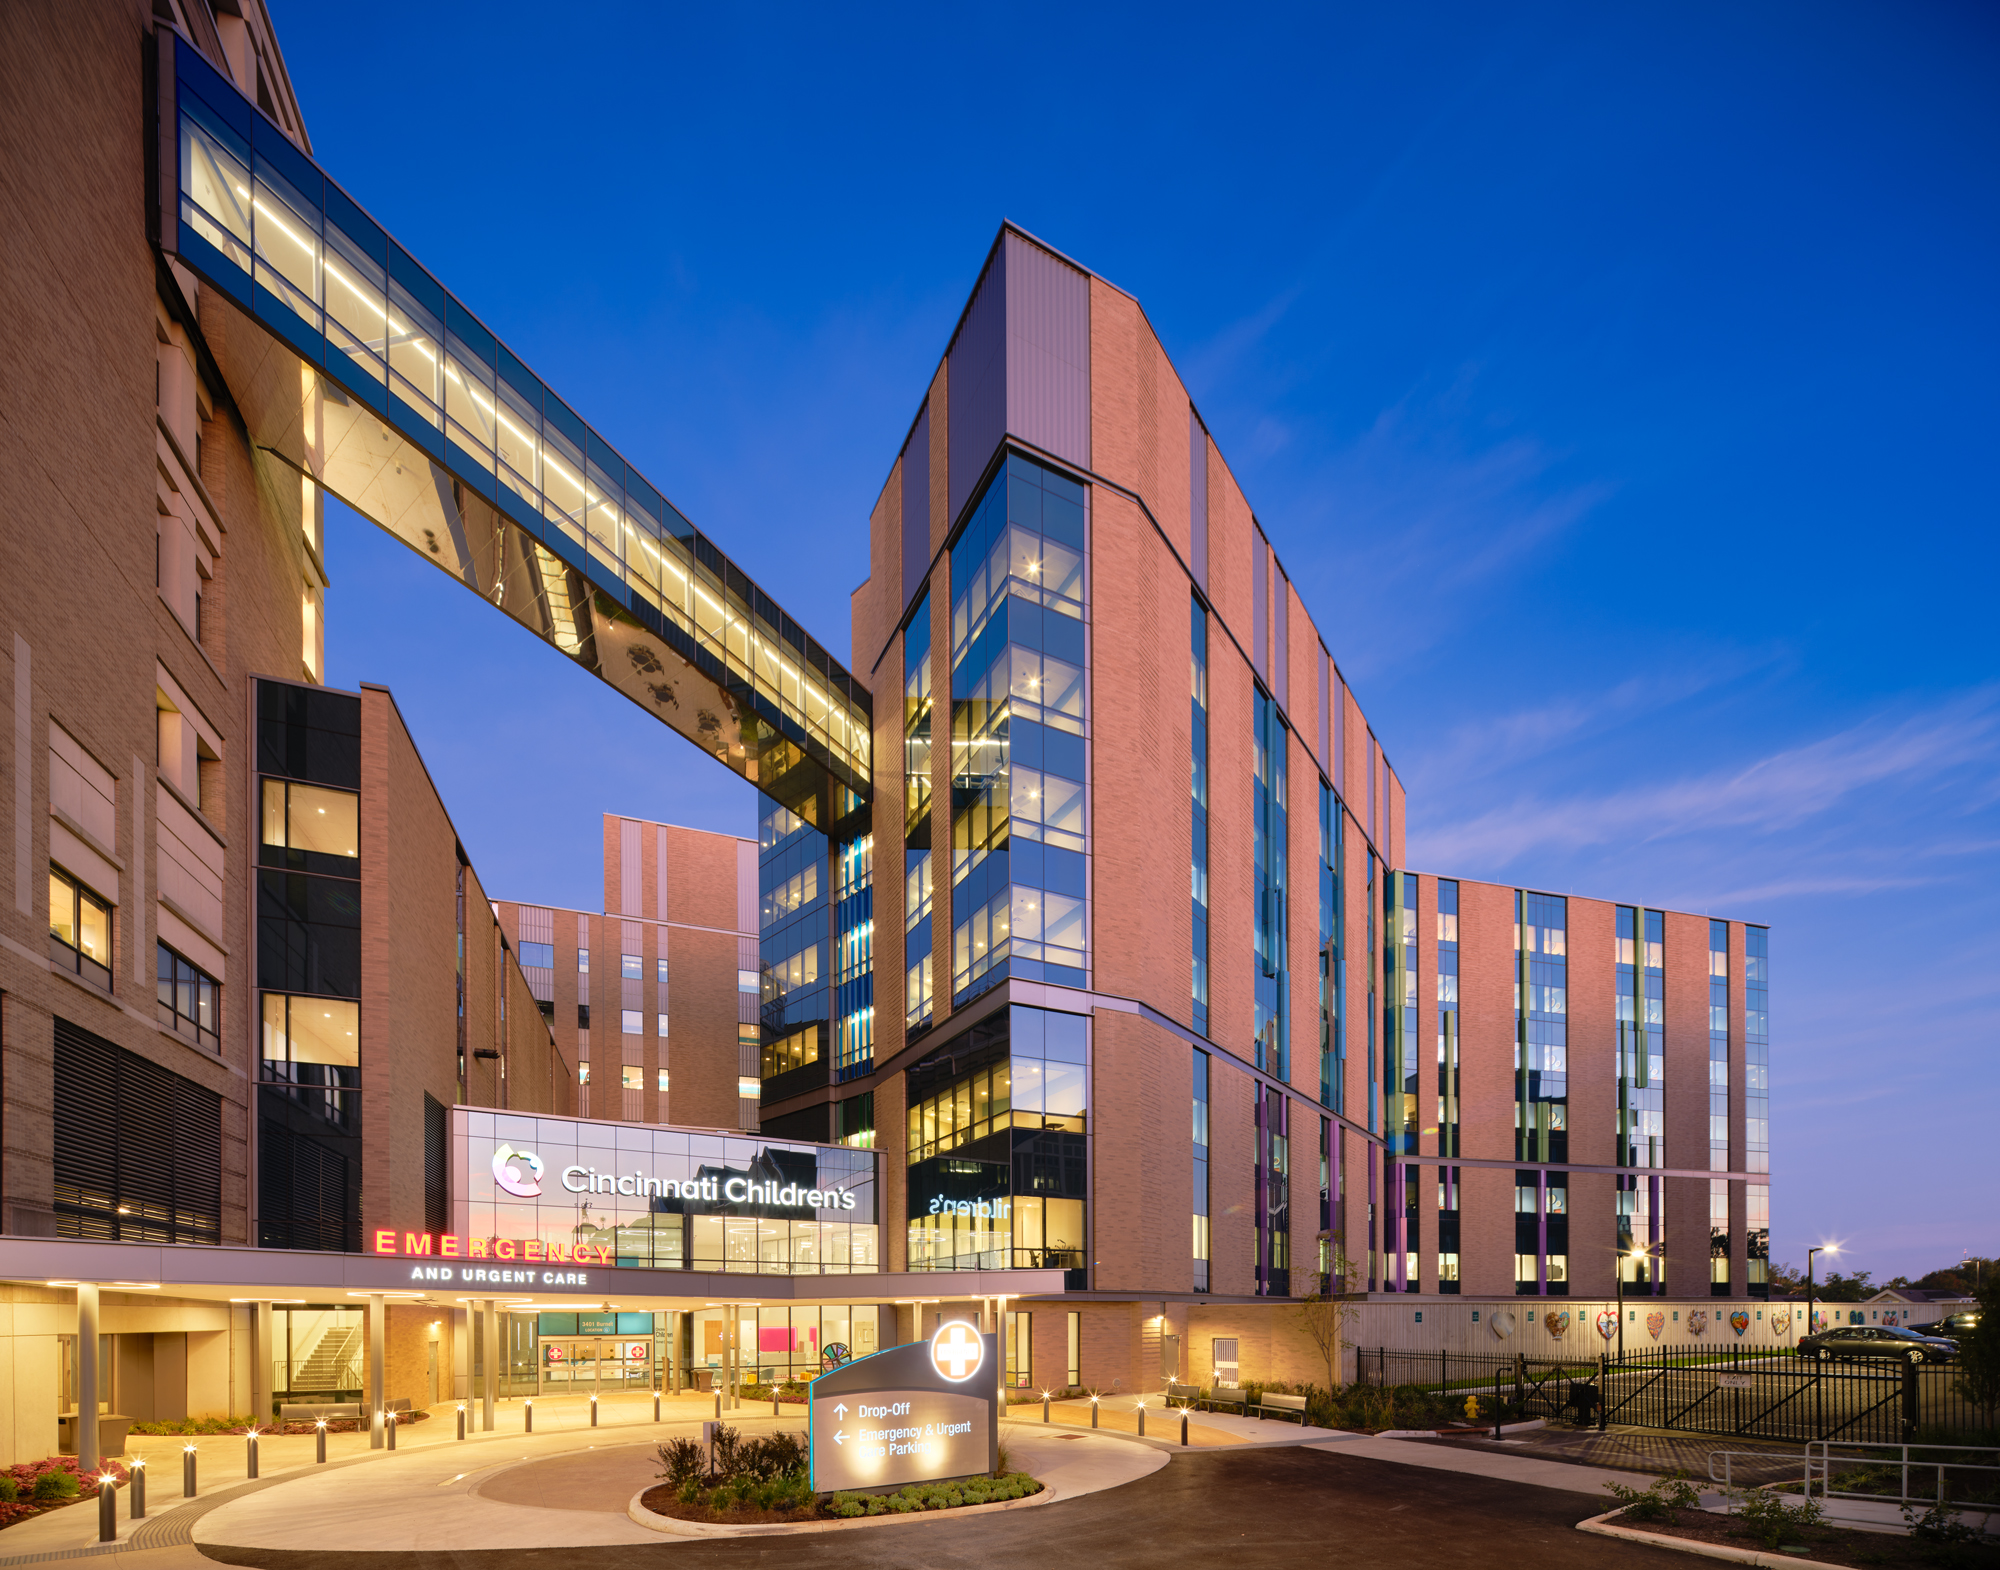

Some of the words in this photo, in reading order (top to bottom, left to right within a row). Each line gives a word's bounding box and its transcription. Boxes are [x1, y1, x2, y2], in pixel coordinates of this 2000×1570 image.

[561, 1165, 718, 1201] Cincinnati
[725, 1177, 856, 1210] Children's
[375, 1230, 612, 1264] EMERGENCY
[411, 1267, 453, 1280] AND
[462, 1269, 536, 1283] URGENT
[543, 1272, 588, 1285] CARE
[858, 1402, 911, 1419] Drop-Off
[858, 1426, 922, 1442] Emergency
[925, 1423, 934, 1436] &
[936, 1421, 971, 1436] Urgent
[859, 1446, 886, 1458] Care
[889, 1441, 931, 1454] Parking
